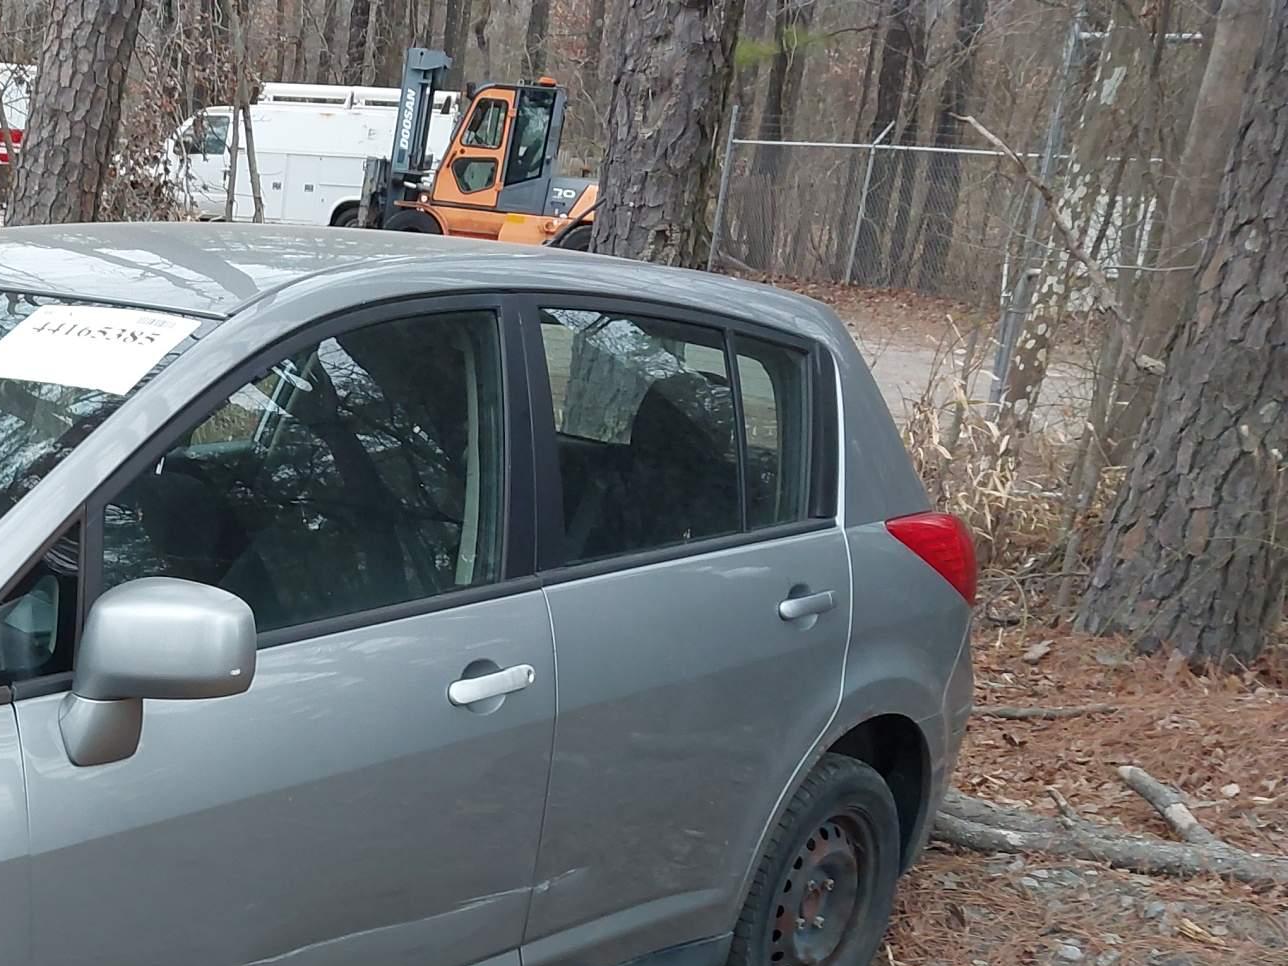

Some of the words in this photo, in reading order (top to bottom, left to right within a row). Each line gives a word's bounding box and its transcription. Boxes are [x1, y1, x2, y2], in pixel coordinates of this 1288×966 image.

[400, 88, 416, 150] DOOSAN
[552, 187, 576, 199] 70
[31, 321, 161, 347] 44165385
